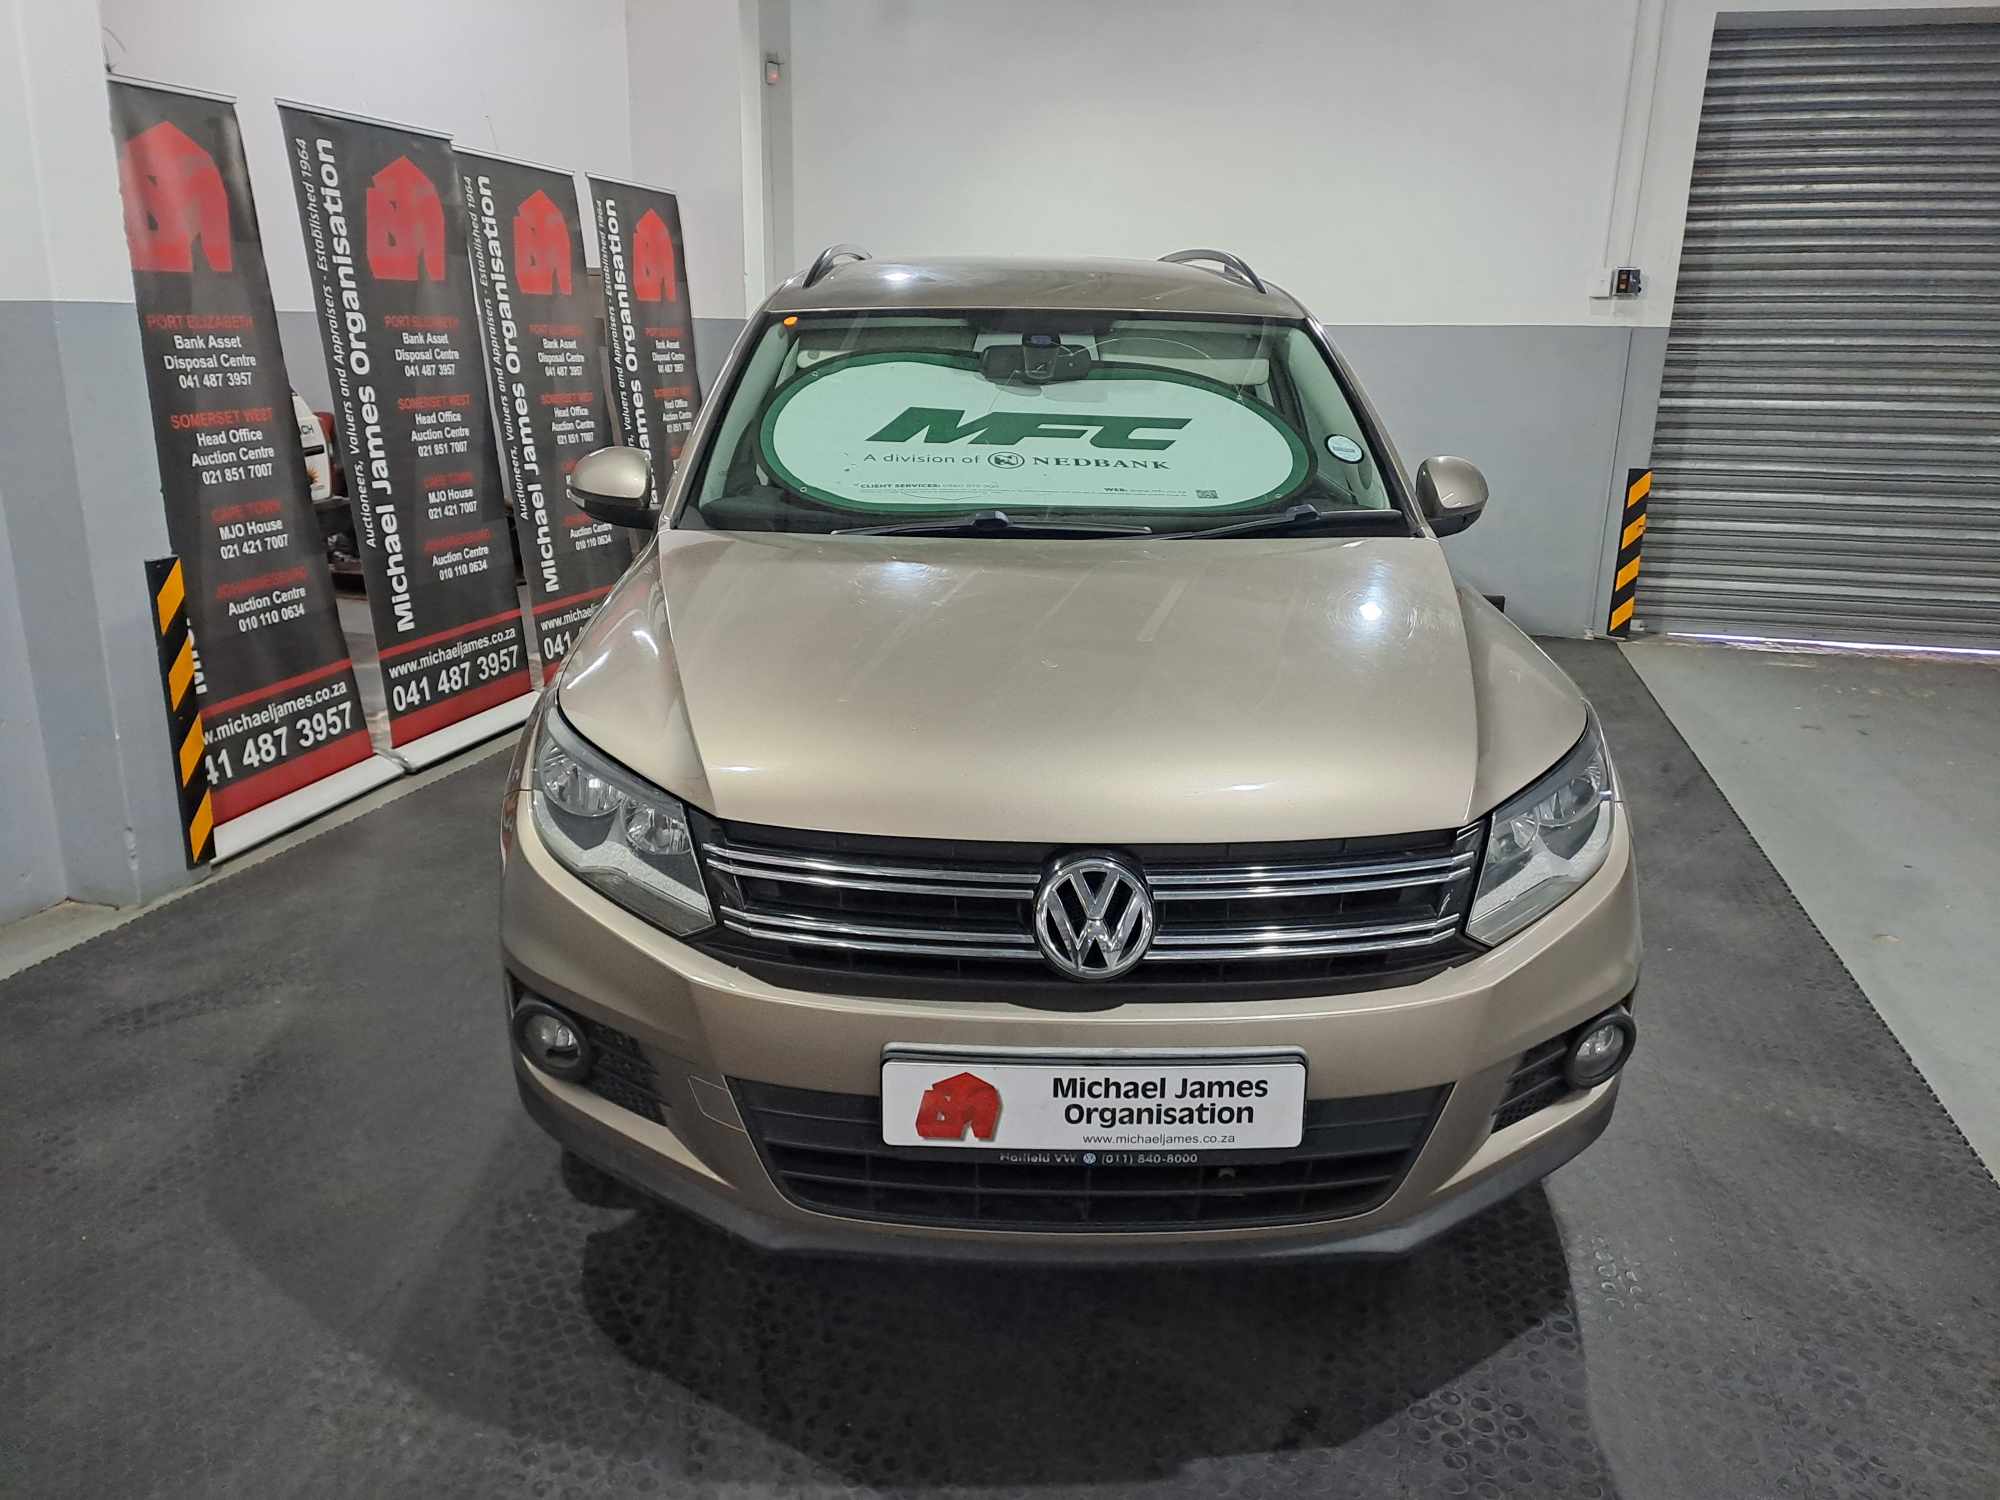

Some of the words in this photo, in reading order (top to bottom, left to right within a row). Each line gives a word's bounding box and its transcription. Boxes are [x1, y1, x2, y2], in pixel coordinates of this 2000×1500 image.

[295, 137, 313, 178] 1964
[302, 181, 329, 272] Established
[316, 138, 371, 376] Organisation
[477, 175, 521, 375] Organisation
[605, 199, 638, 372] Organisation
[322, 284, 345, 365] Appraisers
[402, 332, 424, 344] Bank
[426, 332, 449, 344] Asset
[483, 297, 502, 366] Appraisers
[173, 335, 206, 350] Bank
[208, 335, 242, 349] Asset
[394, 348, 433, 363] Disposal
[434, 348, 460, 360] Centre
[163, 354, 217, 372] Disposal
[220, 354, 257, 367] Centre
[404, 365, 420, 377] 041
[421, 364, 437, 376] 487
[614, 365, 625, 388] and
[178, 375, 200, 389] 041
[203, 373, 224, 388] 487
[227, 372, 252, 386] 3957
[334, 367, 351, 397] and
[494, 366, 506, 392] and
[343, 400, 360, 455] Valuers
[415, 412, 437, 425] Head
[437, 411, 462, 423] Office
[500, 395, 515, 442] Valuers
[631, 379, 650, 449] ames
[196, 431, 226, 447] Head
[229, 428, 263, 444] Office
[358, 385, 392, 496] James
[411, 429, 443, 442] Auction
[444, 426, 470, 439] Centre
[512, 382, 540, 476] James
[864, 406, 1192, 451] MFC
[191, 450, 237, 467] Auction
[239, 446, 275, 461] Centre
[417, 445, 432, 457] 021
[863, 453, 876, 462] A
[883, 452, 955, 465] division
[962, 453, 980, 465] of
[1032, 456, 1171, 470] NEDBANK
[202, 470, 222, 485] 021
[225, 467, 245, 483] 851
[249, 463, 273, 479] 7007
[353, 460, 377, 549] Auctioneers,
[427, 490, 447, 505] MJO
[448, 487, 474, 501] House
[427, 507, 442, 520] 021
[443, 504, 458, 518] 421
[459, 500, 478, 515] 7007
[218, 523, 245, 541] MJO
[248, 519, 284, 536] House
[527, 483, 560, 593] Michael
[220, 545, 241, 560] 021
[242, 540, 263, 555] 421
[266, 534, 290, 550] 7007
[432, 551, 463, 567] Auction
[463, 545, 490, 559] Centre
[375, 503, 416, 633] Michael
[228, 597, 271, 617] Auction
[272, 586, 307, 604] Centre
[238, 617, 259, 633] 010
[260, 610, 280, 627] 110
[282, 603, 306, 622] 0634
[388, 627, 516, 680] www.michaeljames.co.za
[544, 631, 572, 660] 041
[392, 676, 431, 713] 041
[437, 661, 471, 695] 487
[476, 644, 519, 681] 3957
[204, 681, 348, 746] w.michaeljames.co.za
[204, 748, 233, 785] 41
[242, 726, 288, 769] 487
[296, 701, 352, 748] 3957
[1052, 1076, 1167, 1099] Michael
[1175, 1077, 1268, 1099] James
[1064, 1102, 1254, 1128] Organisation
[1082, 1132, 1235, 1146] www.michaeljames.co.za
[1137, 1153, 1198, 1164] 840-8000
